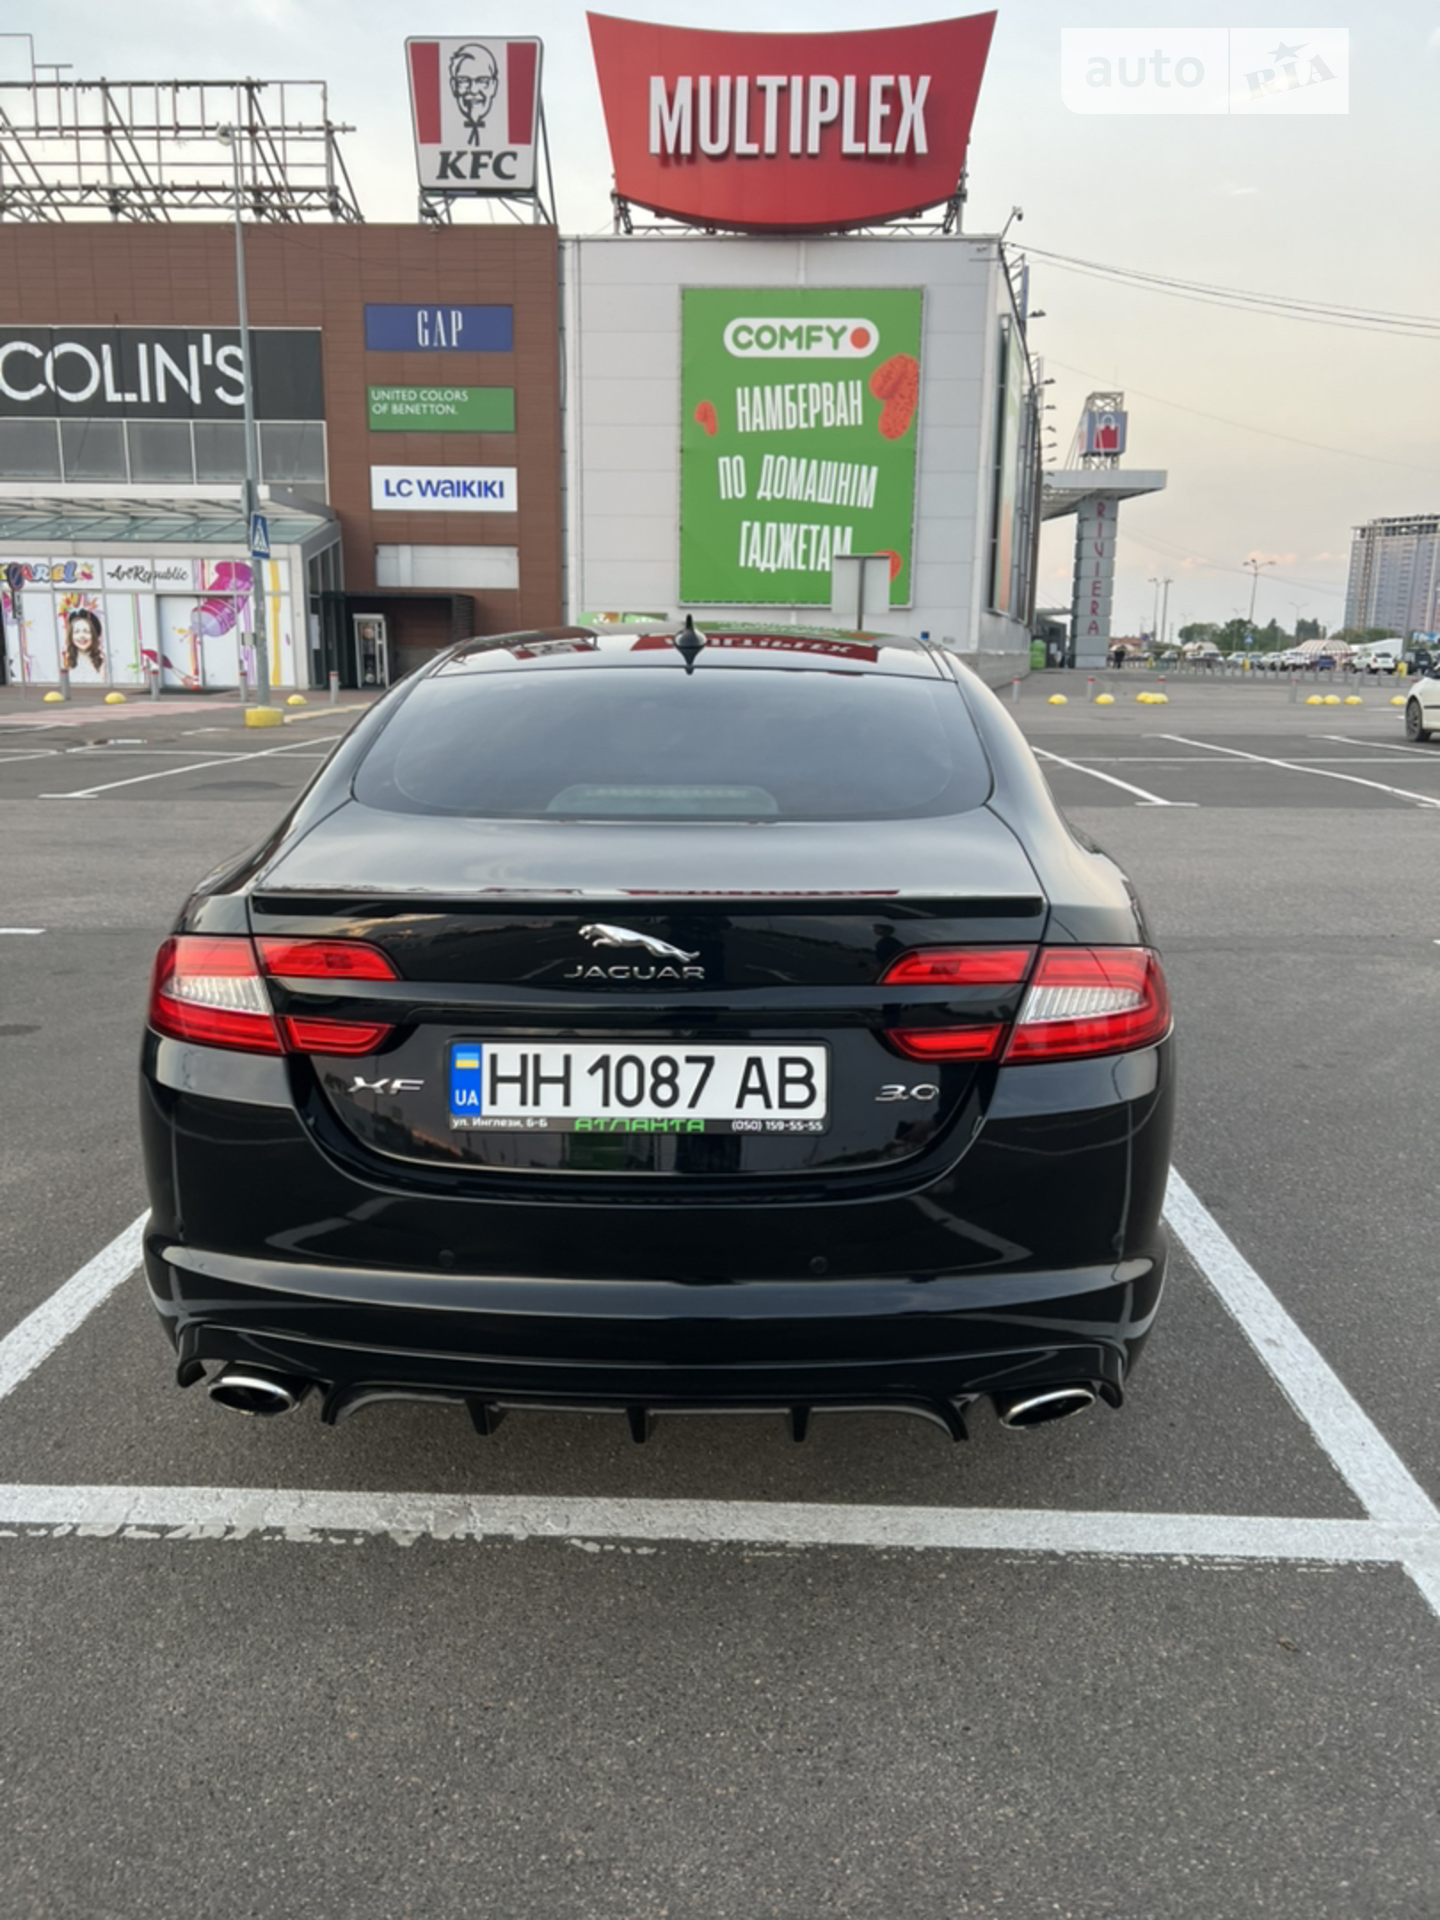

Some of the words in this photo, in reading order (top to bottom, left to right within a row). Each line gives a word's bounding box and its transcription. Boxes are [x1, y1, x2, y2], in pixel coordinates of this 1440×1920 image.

[649, 75, 931, 155] MULTIPLEX
[436, 151, 518, 180] KFC
[417, 309, 463, 347] GAP
[732, 325, 848, 350] COMFY
[0, 333, 248, 405] COLIN'S
[371, 390, 417, 401] UNITED
[419, 390, 468, 402] COLORS
[736, 380, 863, 432] НАМБЕРВАН
[372, 404, 388, 415] OF
[391, 404, 458, 415] BENETTON.
[384, 479, 413, 497] LC
[718, 455, 747, 500] ПО
[757, 454, 878, 509] ДОМАШНІМ
[739, 521, 853, 573] ГАДЖЕТАМ
[1086, 502, 1106, 636] RIVIERA
[563, 965, 705, 980] JAGUAR
[348, 1076, 425, 1094] XF
[455, 1089, 479, 1107] UA
[489, 1053, 572, 1107] HH
[586, 1054, 716, 1109] 1087
[735, 1056, 817, 1110] AB
[875, 1083, 940, 1101] 3.0
[452, 1118, 469, 1130] ул.
[574, 1117, 705, 1132] АТЛАНТА
[731, 1119, 762, 1132] (050)
[765, 1119, 823, 1131] 159-55-55
